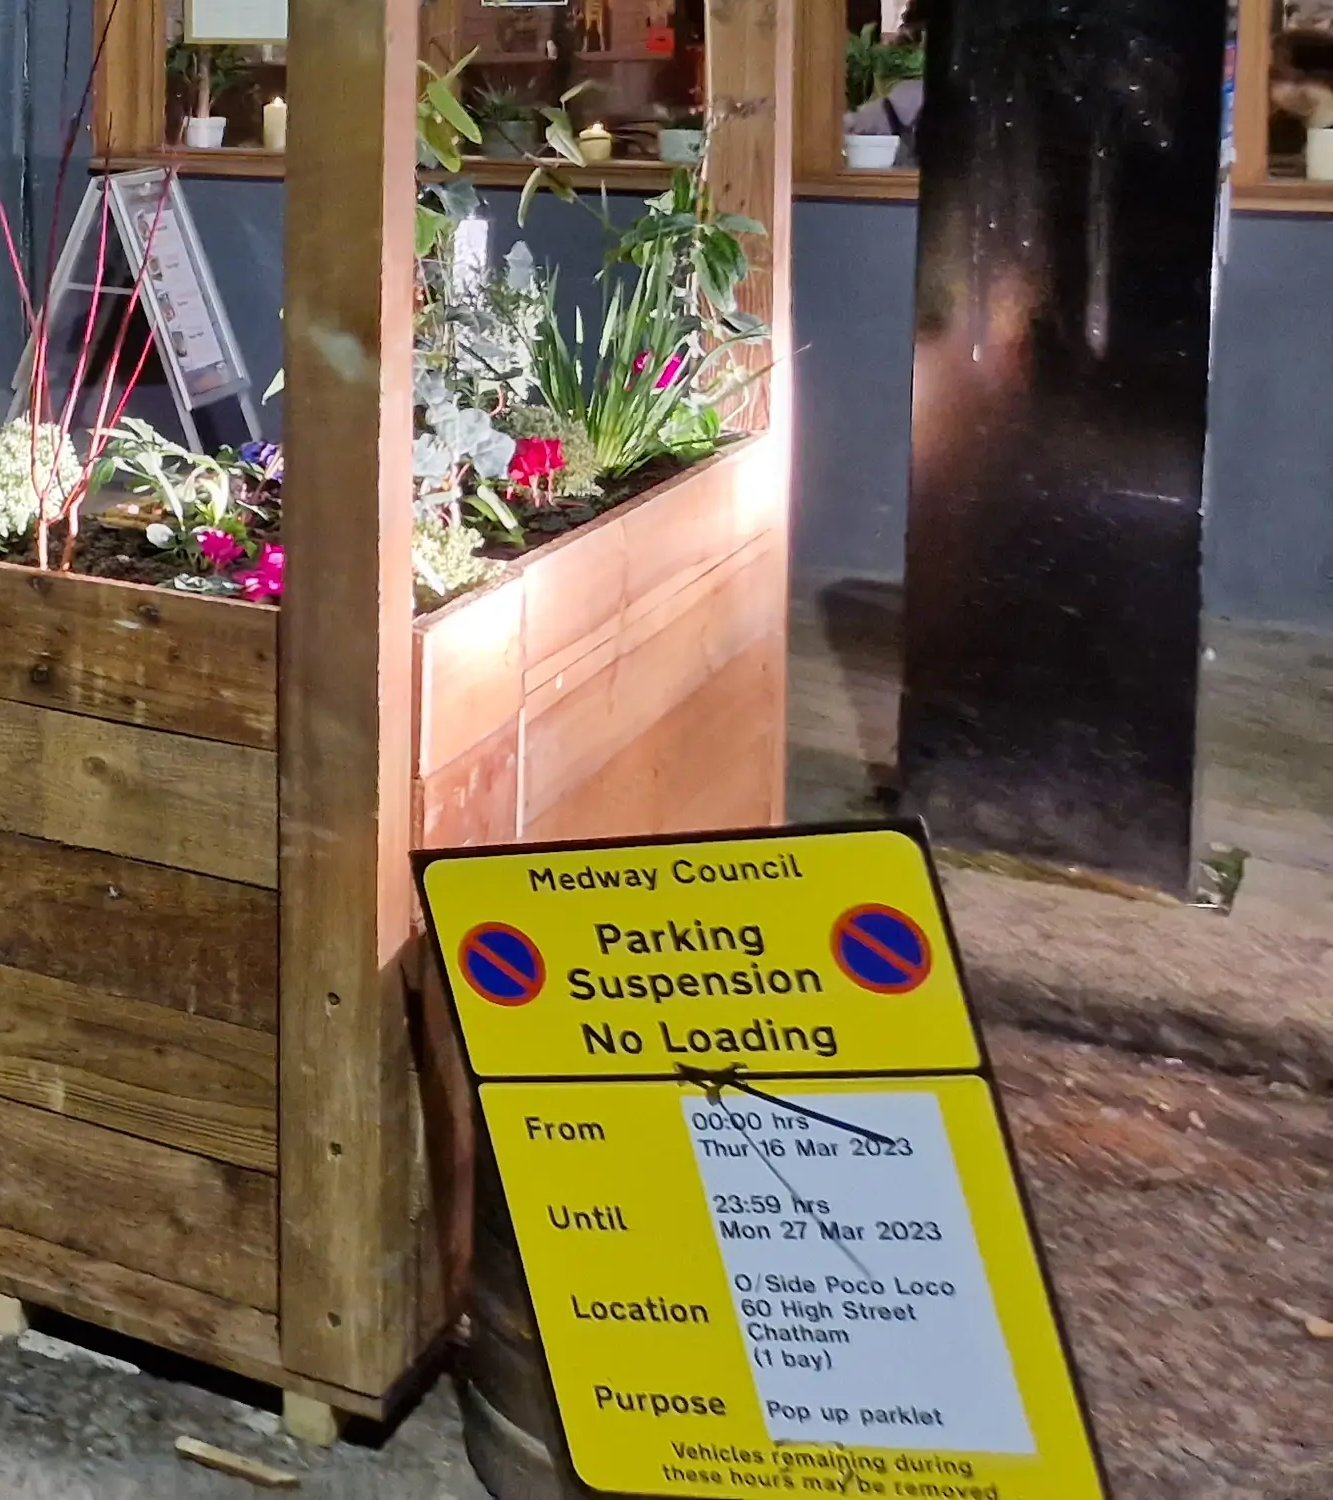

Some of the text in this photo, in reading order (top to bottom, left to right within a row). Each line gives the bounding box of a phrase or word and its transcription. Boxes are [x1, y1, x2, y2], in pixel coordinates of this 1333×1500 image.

[528, 853, 803, 893] Medway Council
[594, 919, 765, 956] Parking
[566, 962, 824, 1003] Suspension
[581, 1019, 839, 1058] No Loading
[524, 1116, 607, 1143] From
[692, 1111, 811, 1133] 00:00 hrs
[697, 1136, 915, 1159] Thur 16 Mar 2023
[546, 1203, 630, 1233] Until
[712, 1195, 831, 1216] 23:59 hrs
[719, 1220, 944, 1243] Mon 27 Mar 2023
[824, 1275, 886, 1297] Poco
[894, 1277, 957, 1298] Loco
[570, 1293, 712, 1325] Location
[740, 1300, 919, 1324] 60 High Street
[747, 1322, 851, 1345] Chatham
[752, 1347, 834, 1372] (1 bay)
[593, 1383, 728, 1419] Purpose
[765, 1399, 945, 1428] Pop up parklet
[671, 1440, 974, 1480] Vehicles remaining during
[662, 1463, 1001, 1500] these hours may be removed
